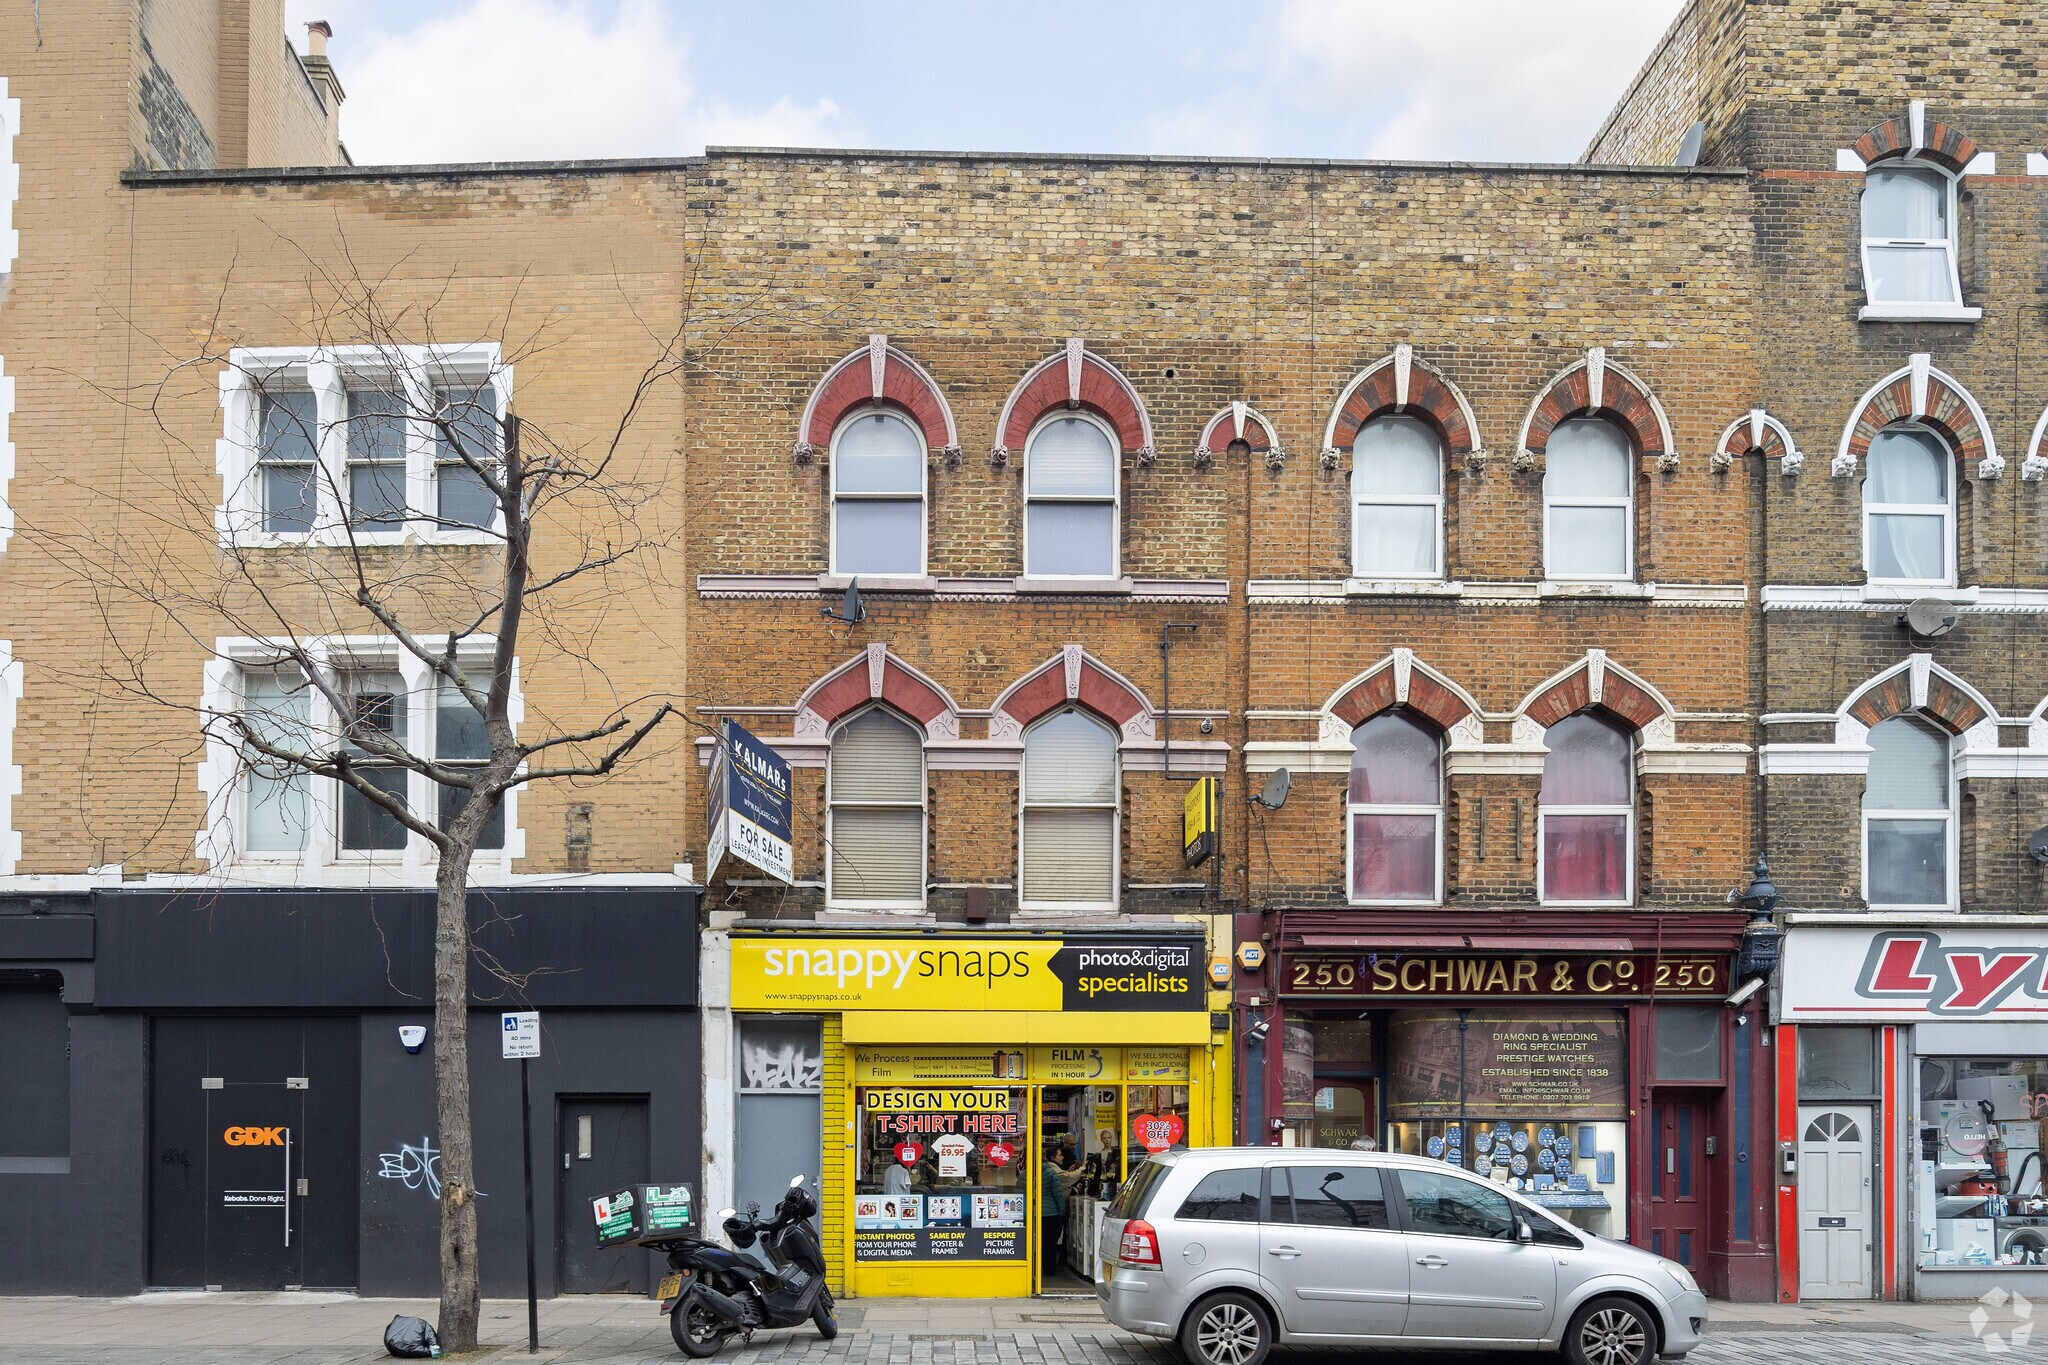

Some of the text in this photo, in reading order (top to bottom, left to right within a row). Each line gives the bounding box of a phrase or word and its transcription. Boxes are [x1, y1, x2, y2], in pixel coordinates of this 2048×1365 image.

[741, 824, 758, 848] FOR
[762, 837, 783, 862] SALE
[1245, 950, 1259, 959] ADT
[1079, 949, 1188, 971] photo&digital
[1214, 965, 1228, 974] ADT
[1868, 937, 2048, 1010] Ly
[1293, 963, 1355, 985] 250
[1373, 959, 1538, 991] SCHWAR
[1551, 960, 1575, 991] &
[1655, 964, 1716, 986] 250
[1078, 972, 1188, 997] specialists
[765, 992, 862, 1002] www.snappysnaps.co.uk
[1493, 1033, 1598, 1041] DIAMOND & WEDDING
[1503, 1043, 1588, 1051] RING SPECIALIST
[855, 1053, 910, 1063] We Process
[1052, 1049, 1085, 1061] FILM
[1496, 1055, 1595, 1063] PRESTIGE WATCHES
[872, 1067, 892, 1076] Film
[1482, 1068, 1609, 1077] ESTABLISHED SINCE 1838
[867, 1092, 942, 1109] DESIGN
[949, 1092, 1007, 1109] YOUR
[877, 1115, 1017, 1133] T-SHIRT HERE
[1147, 1121, 1171, 1131] 30%
[224, 1126, 286, 1146] GDK
[1147, 1130, 1169, 1139] OFF
[1320, 1128, 1358, 1137] SCHWAR
[1335, 1138, 1350, 1146] CO.
[941, 1148, 965, 1157] £9.95
[267, 1195, 285, 1203] Right.
[598, 1204, 607, 1219] L
[929, 1232, 950, 1240] SAME
[857, 1249, 863, 1257] &
[863, 1249, 890, 1257] DIGITAL
